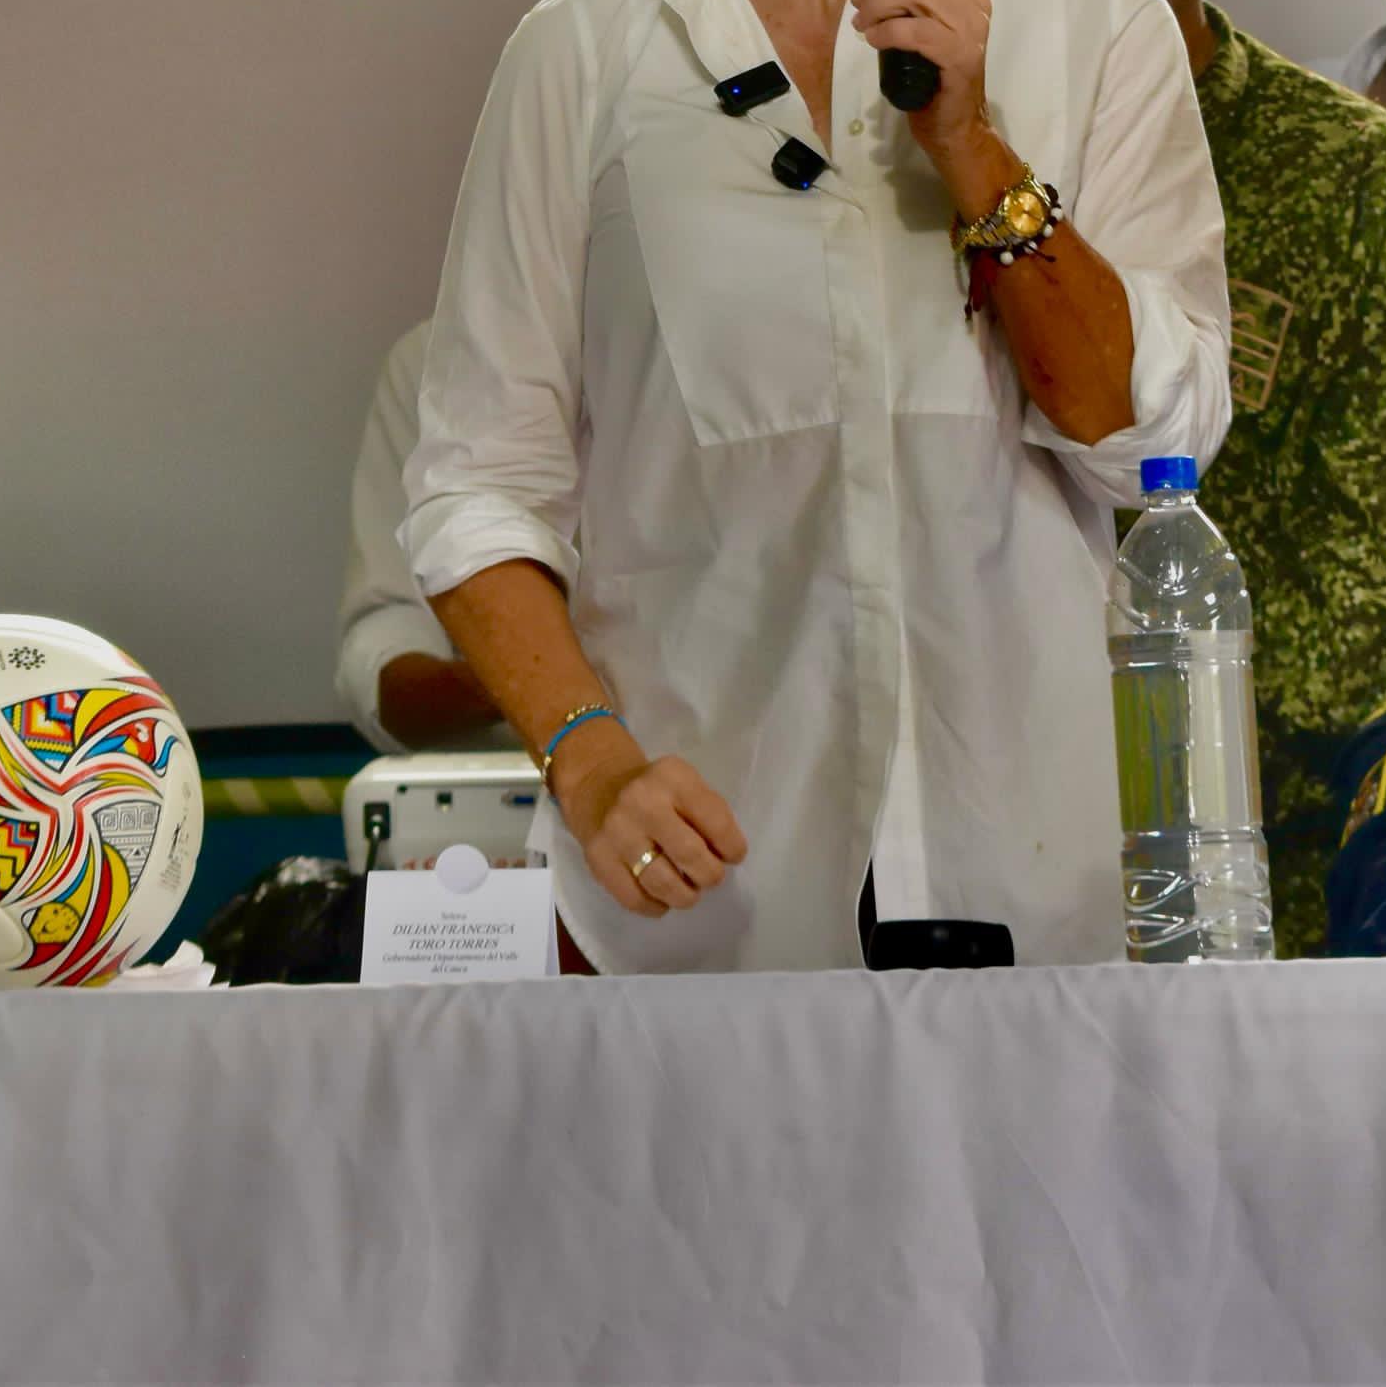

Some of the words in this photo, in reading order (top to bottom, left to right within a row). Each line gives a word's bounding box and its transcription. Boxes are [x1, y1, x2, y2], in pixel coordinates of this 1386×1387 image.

[392, 924, 439, 935] DILIAN
[441, 923, 516, 935] FRANCISCA
[409, 939, 446, 950] TORO
[449, 938, 501, 950] TORRES
